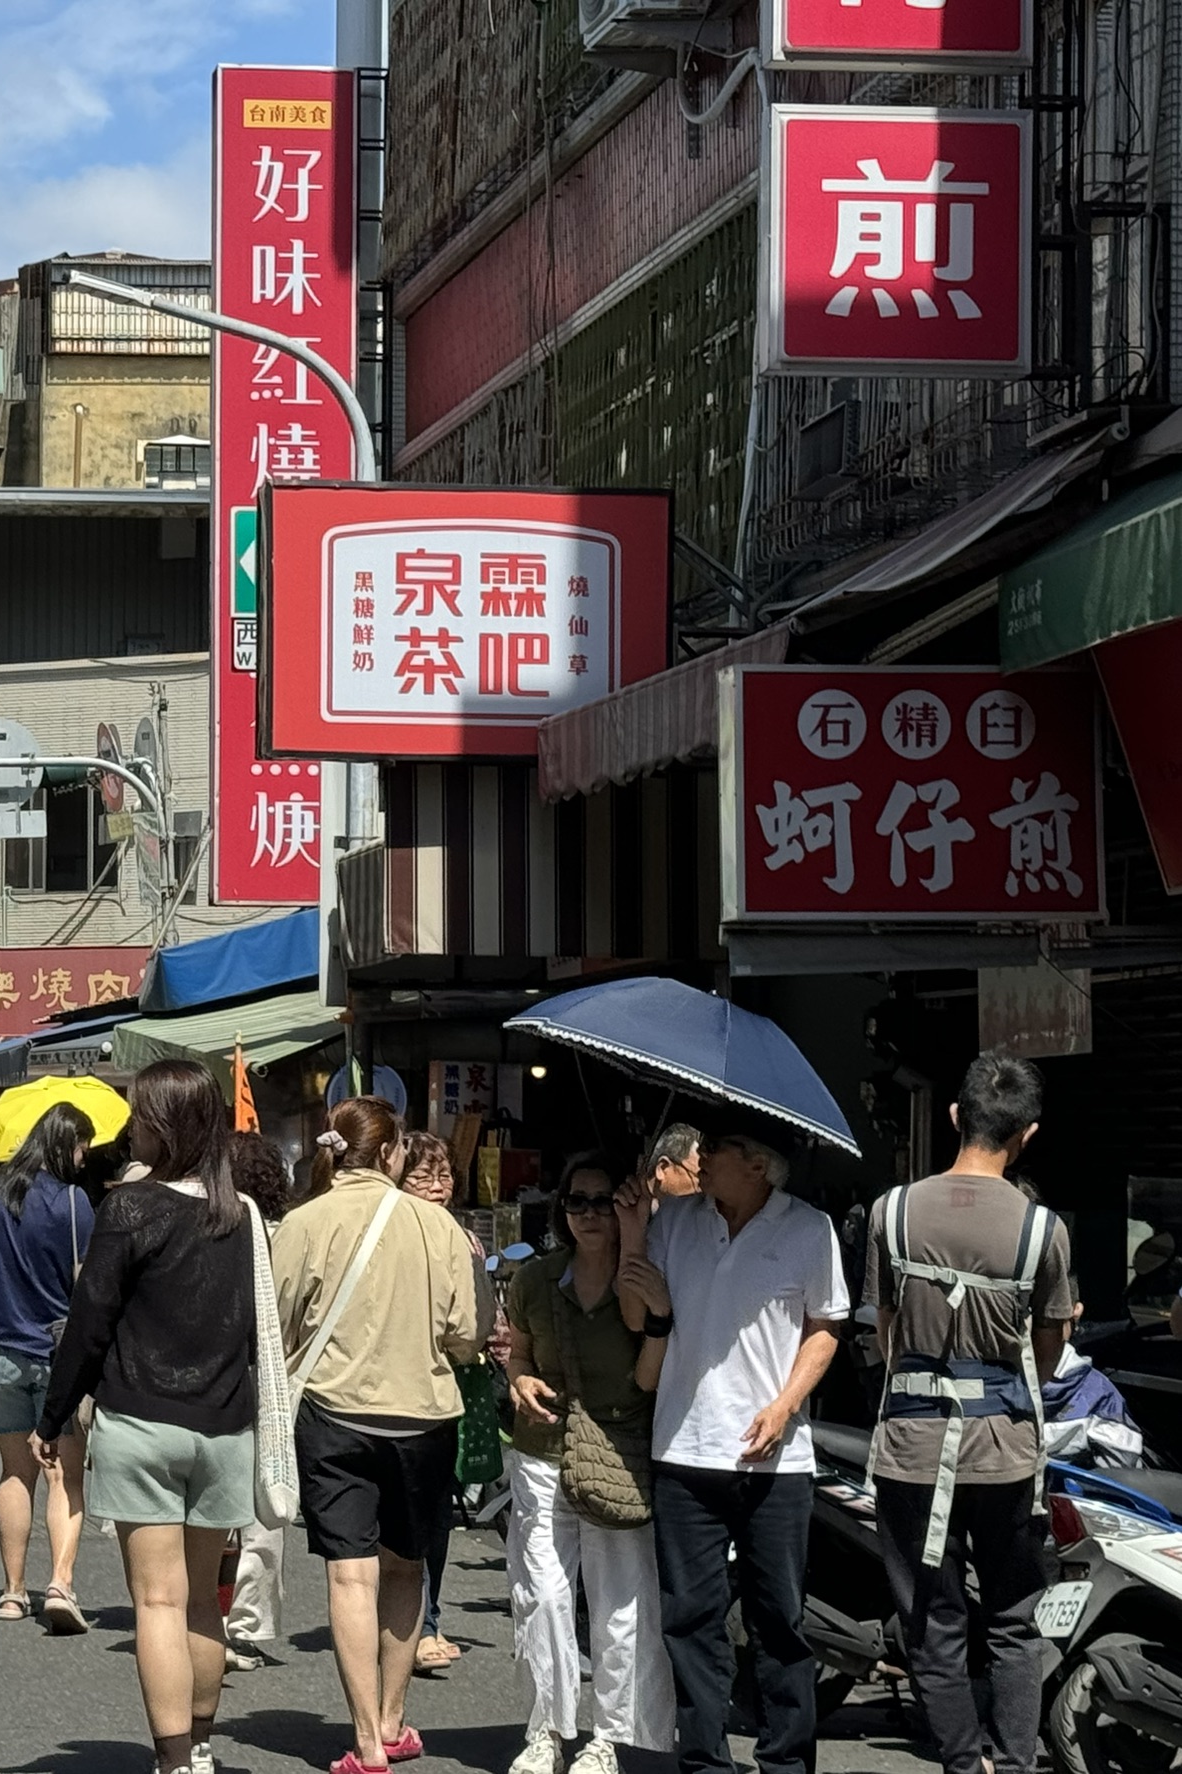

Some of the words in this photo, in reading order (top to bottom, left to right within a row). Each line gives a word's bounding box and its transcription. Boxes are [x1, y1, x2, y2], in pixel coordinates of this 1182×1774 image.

[249, 104, 327, 124] 台南美食
[821, 158, 990, 320] 煎
[353, 571, 375, 672] 黑糖鮮奶
[392, 548, 547, 618] 泉霖
[567, 575, 590, 676] 燒仙草
[392, 626, 550, 698] 茶吧
[755, 771, 1084, 899] 蚵仔煎
